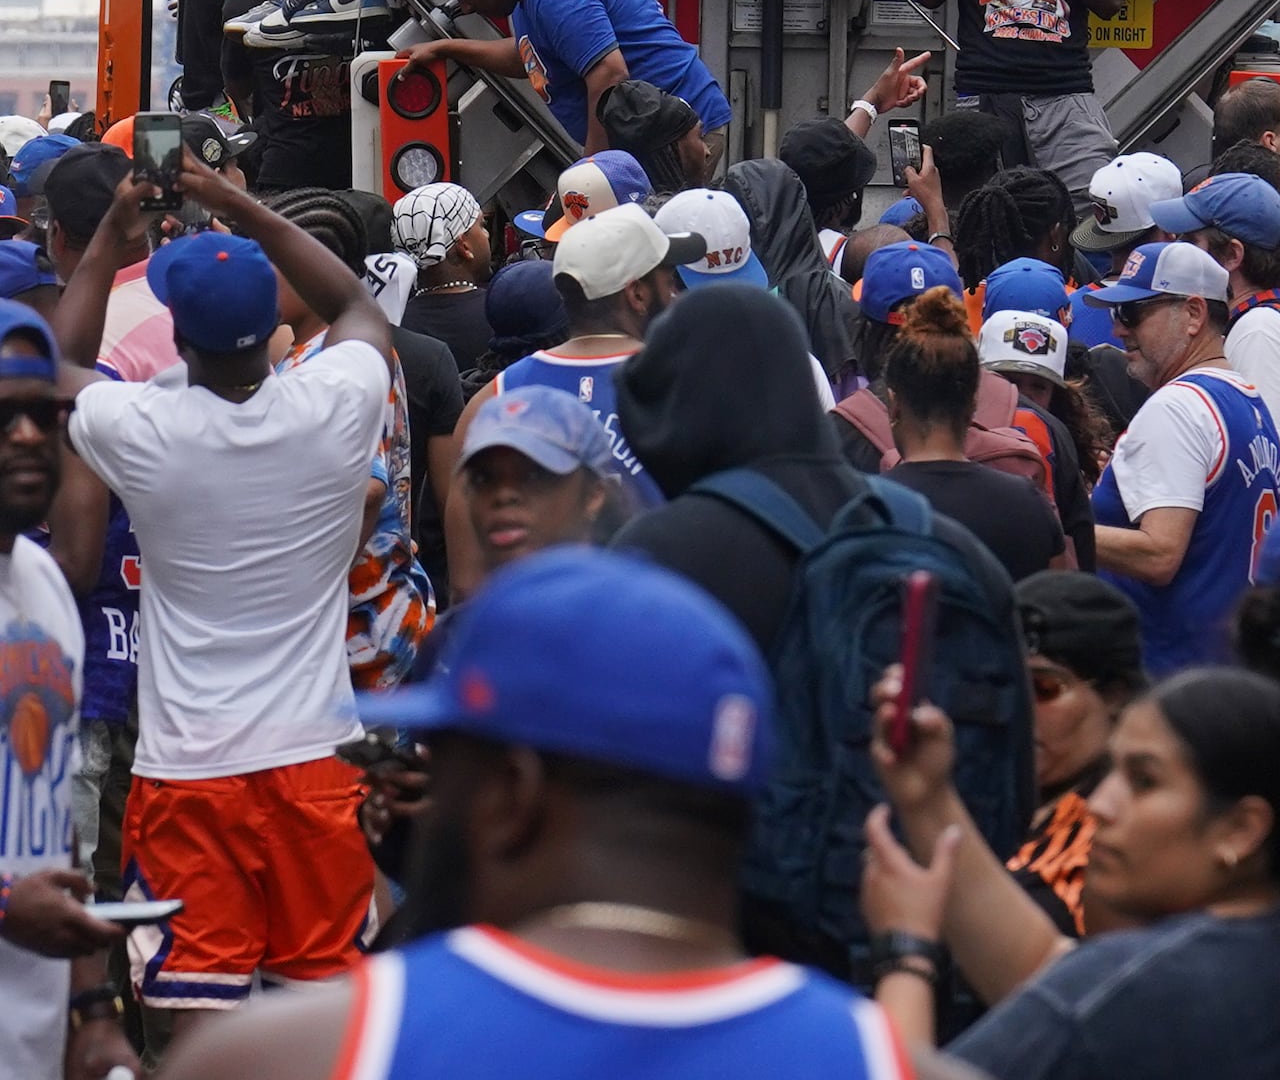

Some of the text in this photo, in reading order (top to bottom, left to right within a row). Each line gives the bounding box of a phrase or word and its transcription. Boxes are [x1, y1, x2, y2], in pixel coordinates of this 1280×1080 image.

[1096, 27, 1110, 41] ON
[1114, 28, 1146, 41] RIGHT
[703, 247, 741, 270] NYC
